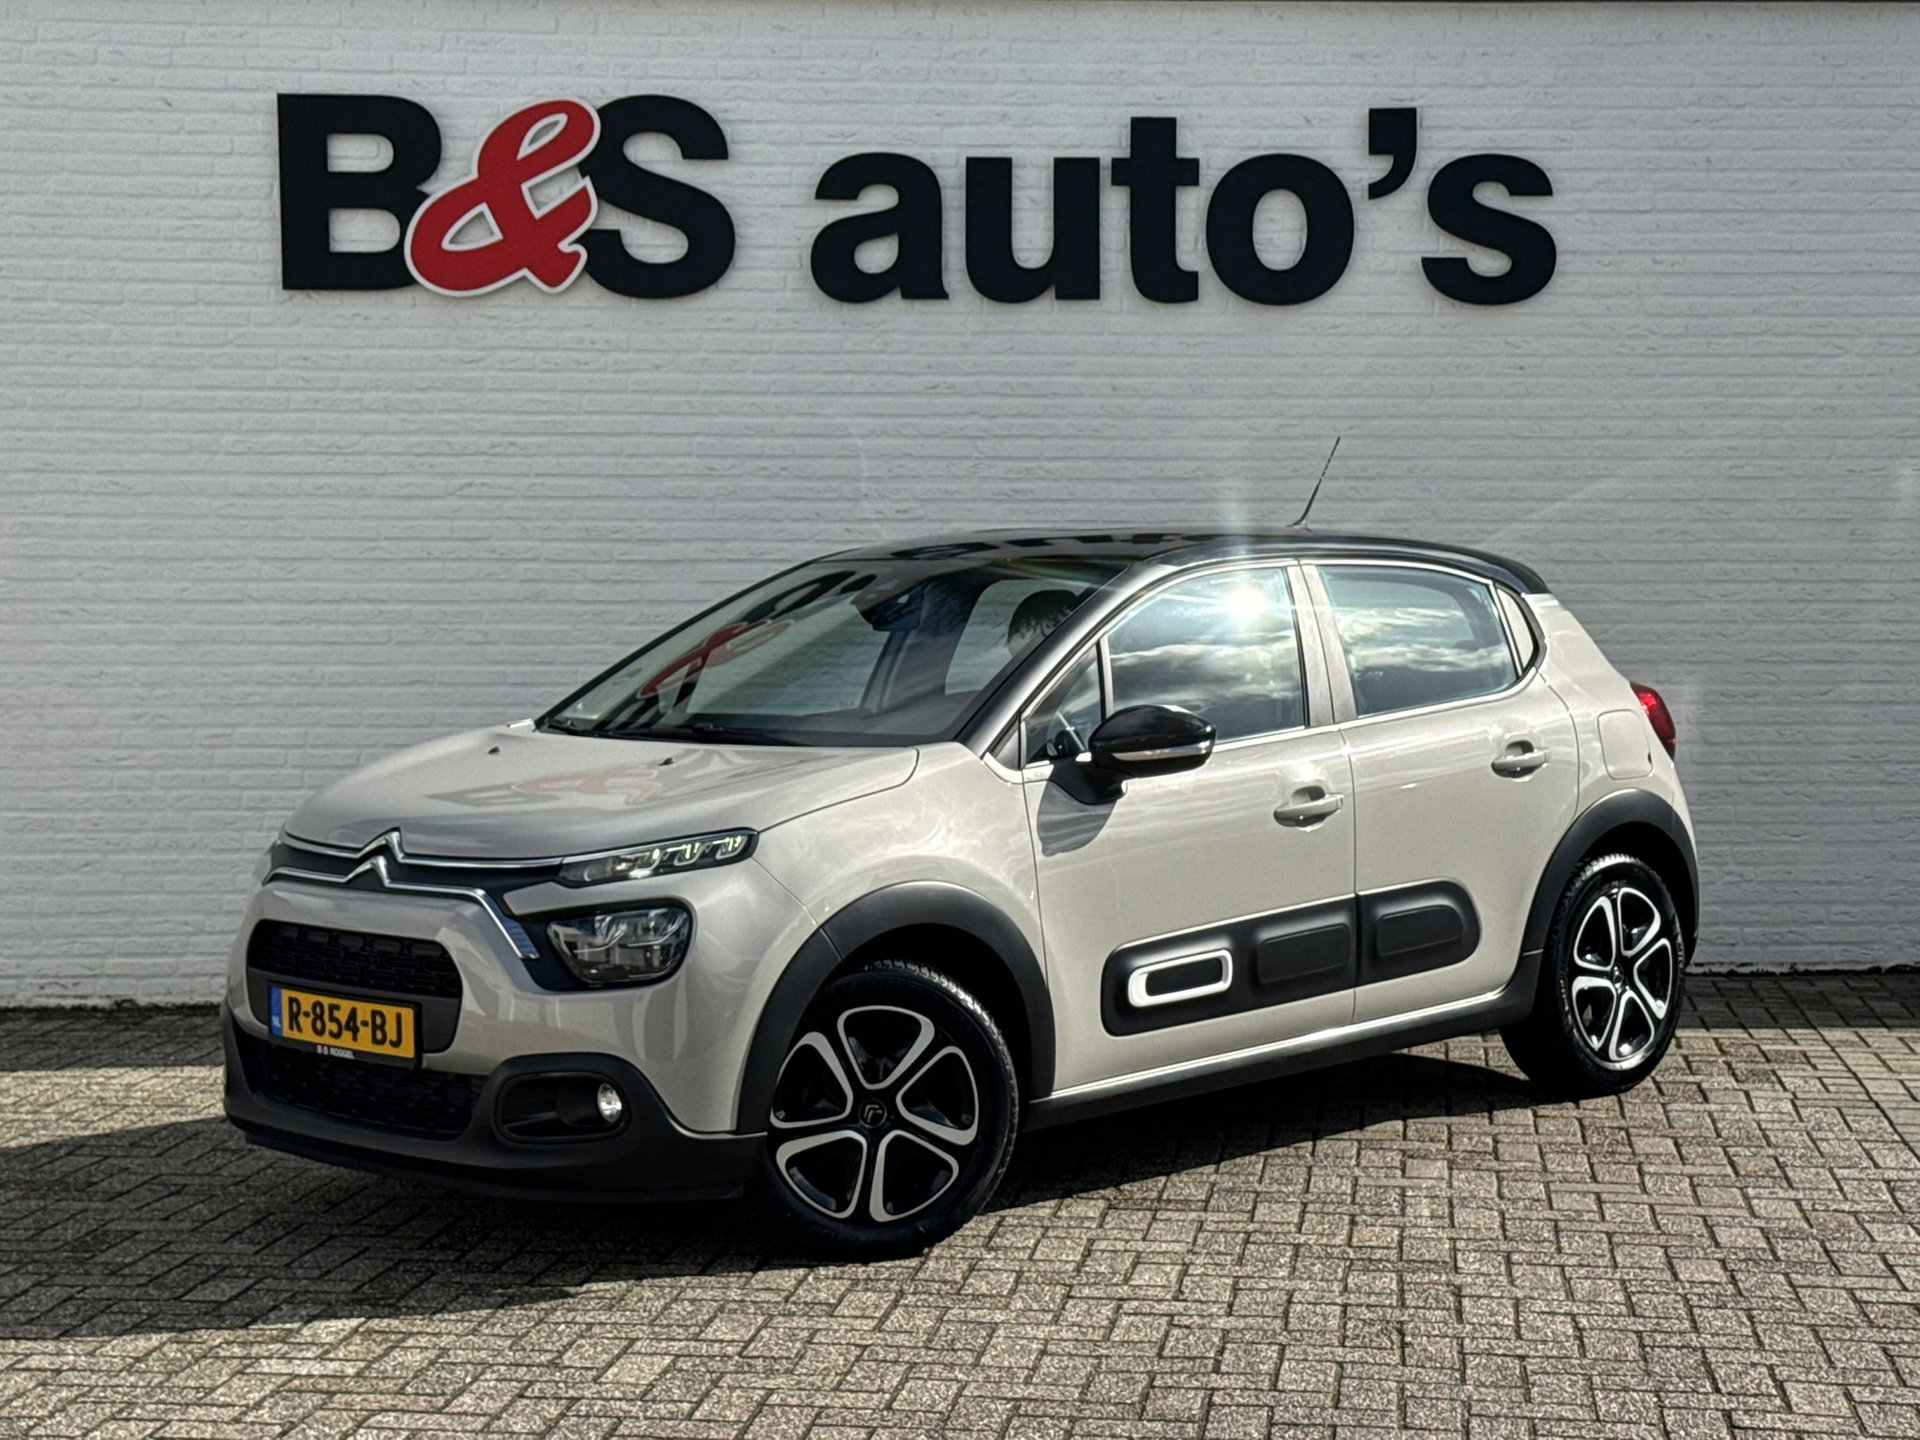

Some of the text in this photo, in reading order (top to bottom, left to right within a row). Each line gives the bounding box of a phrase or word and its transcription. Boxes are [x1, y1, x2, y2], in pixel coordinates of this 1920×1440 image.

[277, 93, 1557, 306] B&S auto's
[288, 996, 403, 1048] R-854-BJ
